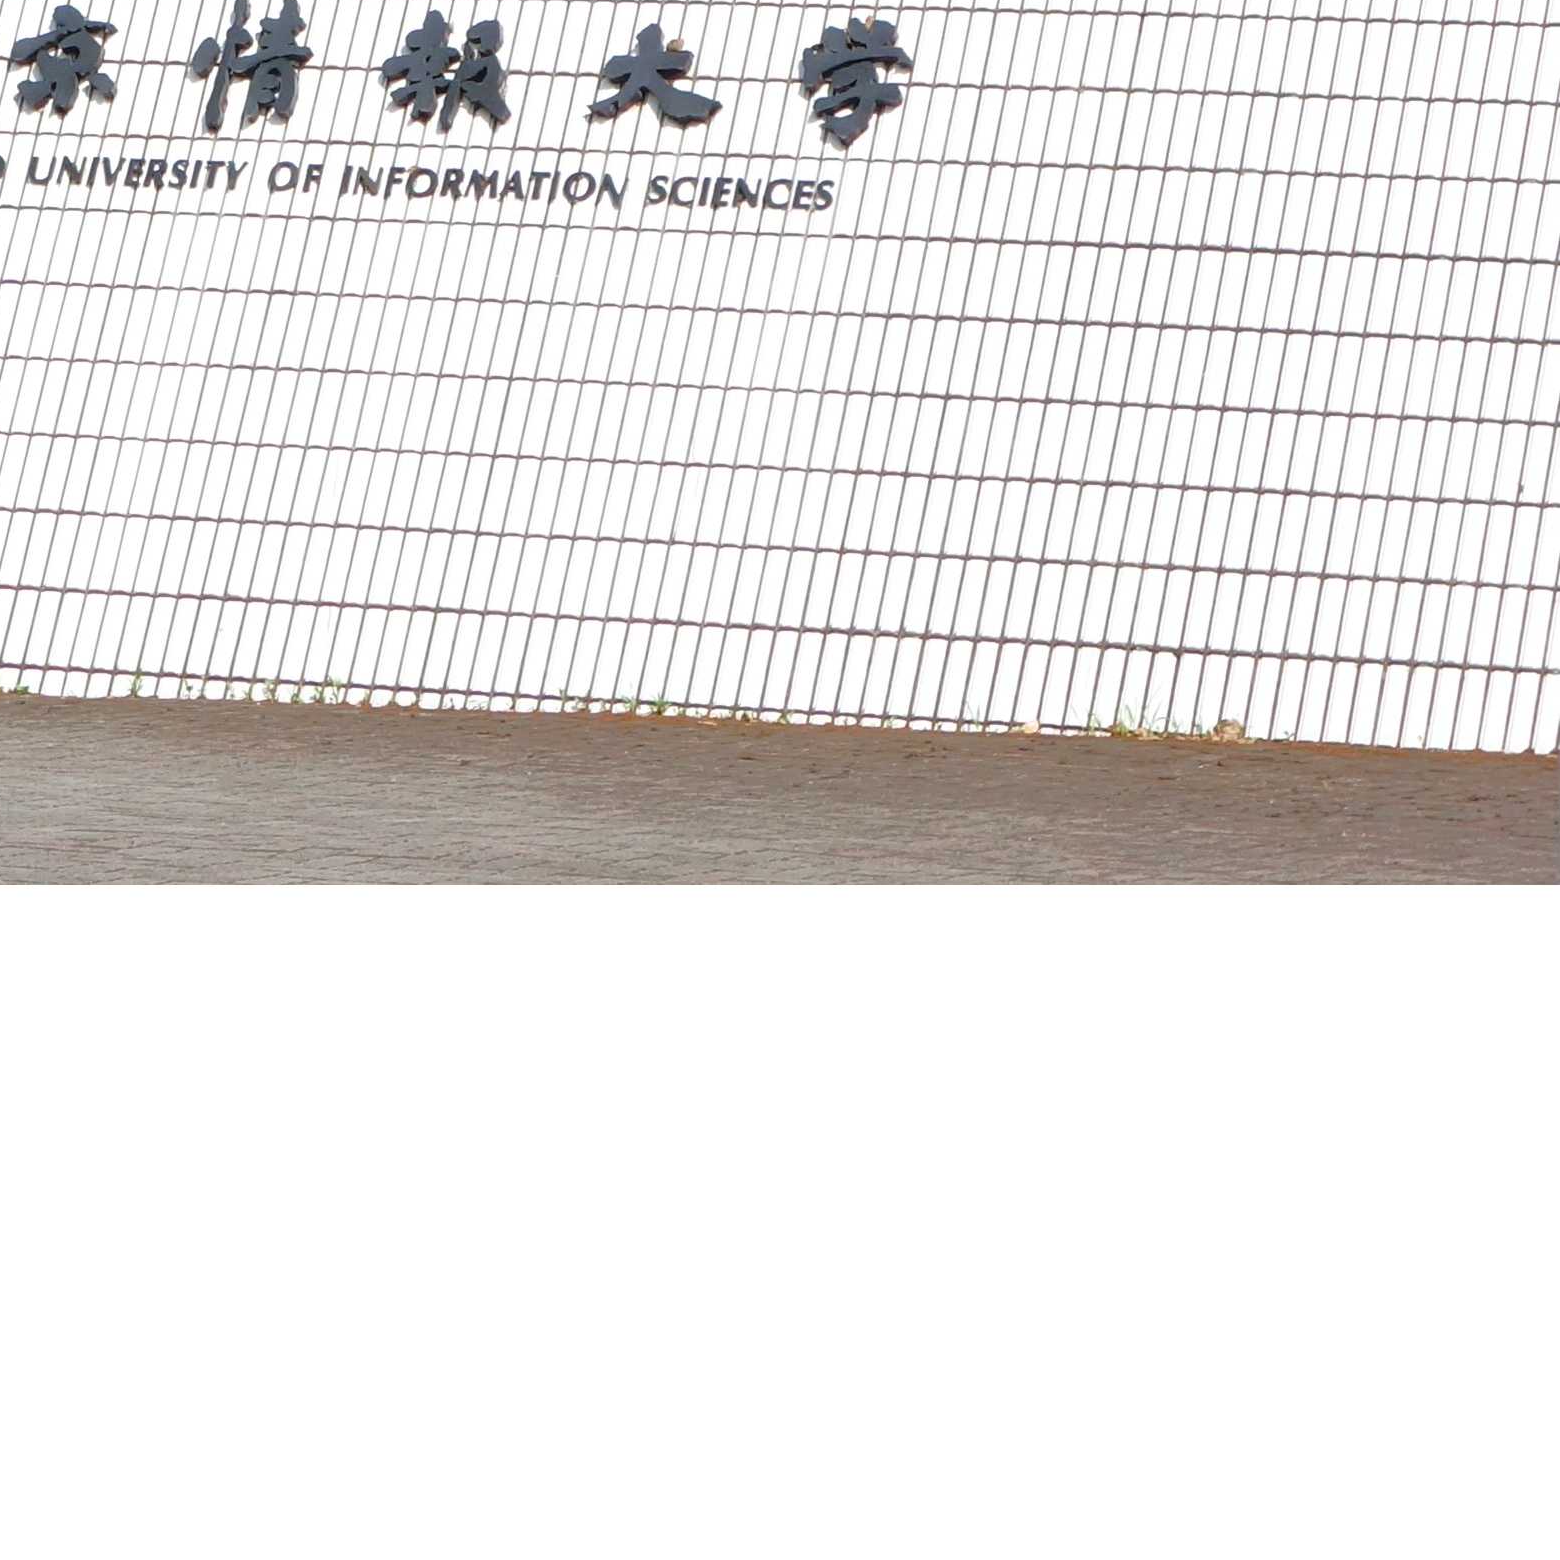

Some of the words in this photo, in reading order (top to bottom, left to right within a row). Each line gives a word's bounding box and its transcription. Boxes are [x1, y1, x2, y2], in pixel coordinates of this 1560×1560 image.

[27, 155, 249, 191] UNIVERSITY
[269, 160, 324, 193] OF
[338, 165, 629, 208] INFORMATION
[644, 174, 835, 211] SCIENCES
